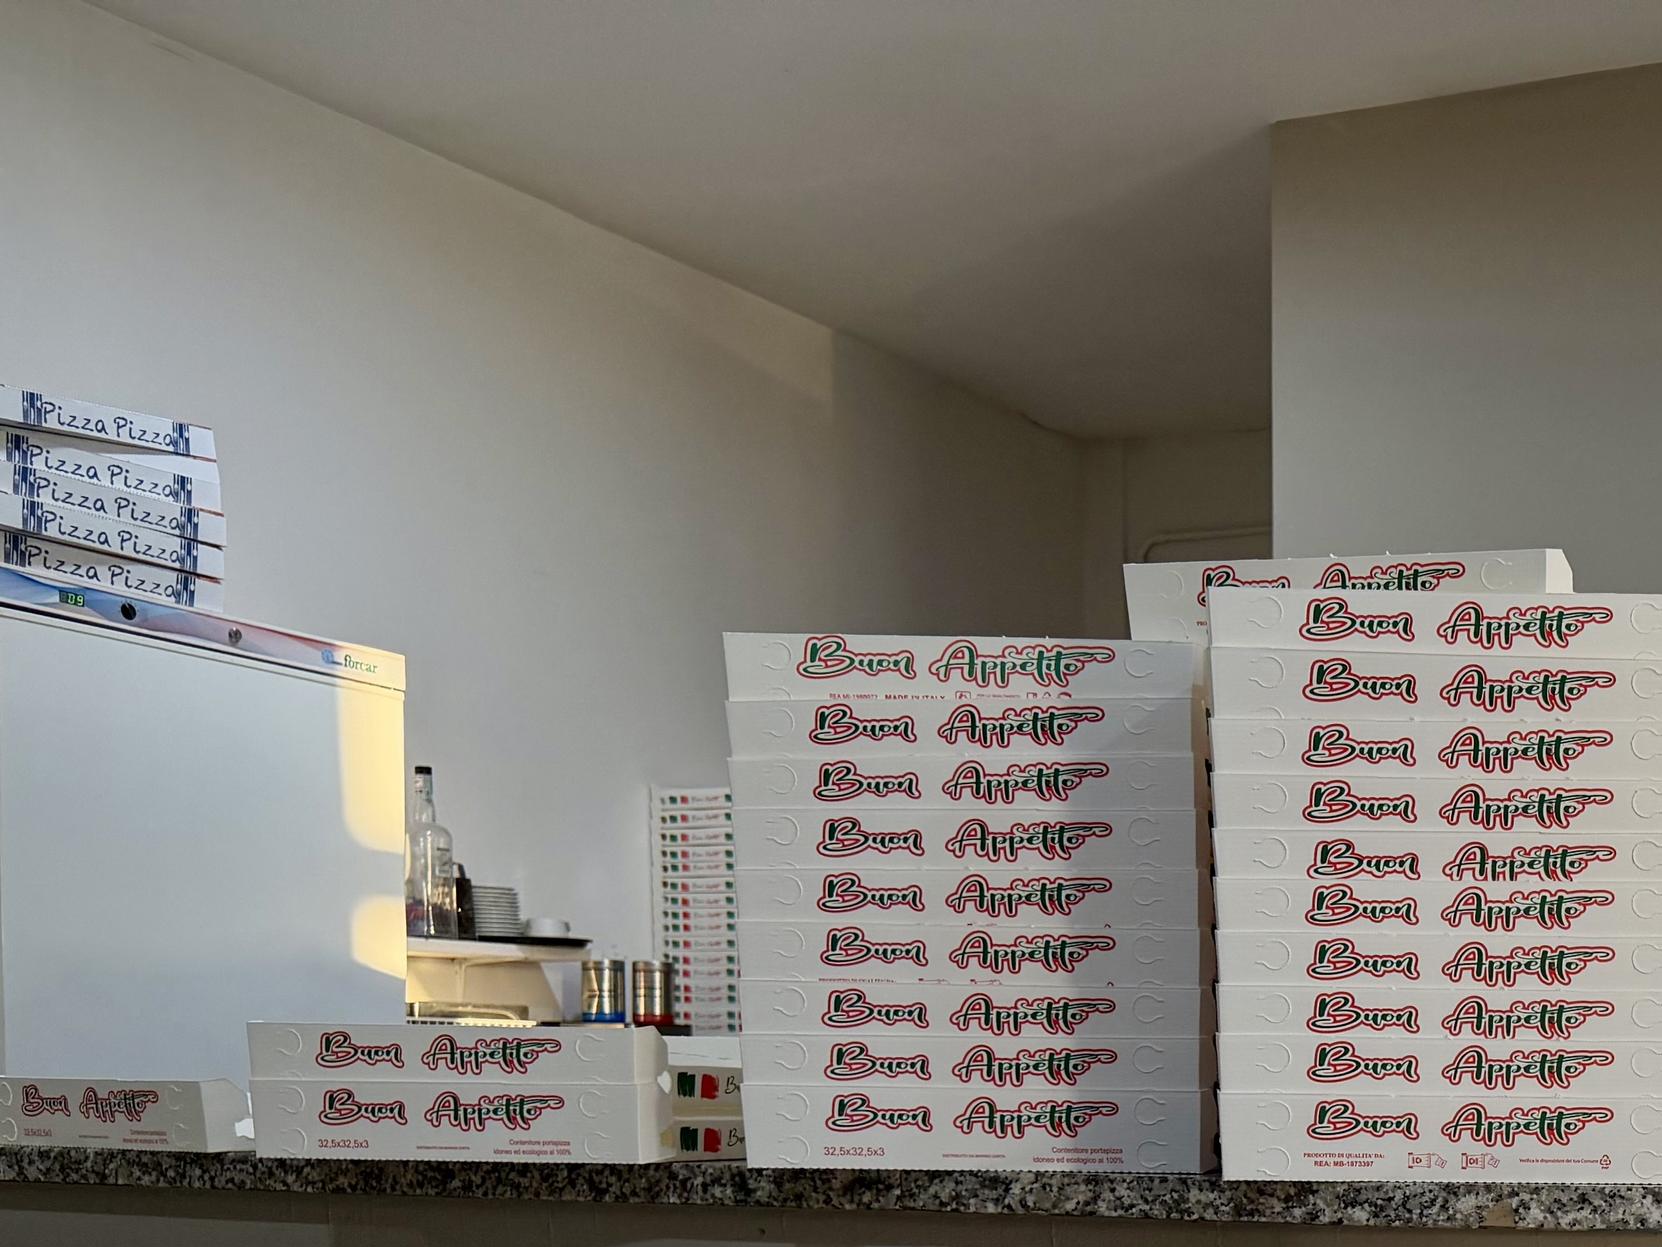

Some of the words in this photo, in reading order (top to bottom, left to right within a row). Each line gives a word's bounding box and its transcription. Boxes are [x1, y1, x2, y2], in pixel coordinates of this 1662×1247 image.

[41, 401, 108, 435] Pizza
[114, 416, 175, 448] Pizza
[27, 444, 101, 481] Pizza
[108, 464, 175, 500] Pizza
[34, 477, 108, 514] Pizza
[115, 496, 182, 532] Pizza
[41, 510, 111, 547] Pizza
[118, 530, 182, 565] Pizza
[25, 545, 100, 581] Pizza
[108, 565, 178, 600] Pizza
[1299, 597, 1415, 642] Buon
[1437, 601, 1613, 650] Appetito
[797, 635, 916, 679] Buon
[929, 639, 1116, 687] Appetito
[1303, 658, 1418, 703] Buon
[1440, 663, 1615, 712] Appetito
[809, 703, 917, 744] Buon
[938, 704, 1105, 747] Appetito
[1302, 723, 1416, 767] Buon
[1438, 726, 1613, 773] Appetito
[814, 760, 921, 801] Buon
[943, 760, 1109, 804] Appetito
[1302, 779, 1417, 825] Buon
[1439, 784, 1614, 830] Appetito
[817, 817, 925, 857] Buon
[945, 818, 1112, 862] Appetito
[1307, 838, 1421, 880] Buon
[1442, 840, 1616, 881] Appetito
[818, 872, 925, 912] Buon
[946, 874, 1112, 918] Appetito
[1305, 883, 1420, 926] Buon
[1441, 886, 1615, 931] Appetito
[821, 926, 928, 967] Buon
[949, 930, 1116, 974] Appetito
[1306, 937, 1420, 980] Buon
[1442, 941, 1615, 987] Appetito
[822, 988, 929, 1028] Buon
[950, 993, 1116, 1036] Appetito
[1306, 991, 1420, 1033] Buon
[1442, 995, 1615, 1040] Appetito
[316, 1031, 404, 1068] Buon
[421, 1033, 562, 1075] Appetito
[824, 1041, 931, 1082] Buon
[953, 1044, 1118, 1087] Appetito
[1306, 1041, 1420, 1083] Buon
[1442, 1045, 1615, 1089] Appetito
[22, 1084, 71, 1117] Buon
[79, 1086, 160, 1123] Appetito
[319, 1088, 408, 1126] Buon
[424, 1090, 565, 1132] Appetito
[826, 1093, 933, 1132] Buon
[954, 1096, 1119, 1139] Appetito
[1306, 1099, 1420, 1141] Buon
[1442, 1102, 1615, 1147] Appetito
[318, 1138, 369, 1149] 32,5x32,5x3
[823, 1146, 885, 1157] 32,5x32,5x3
